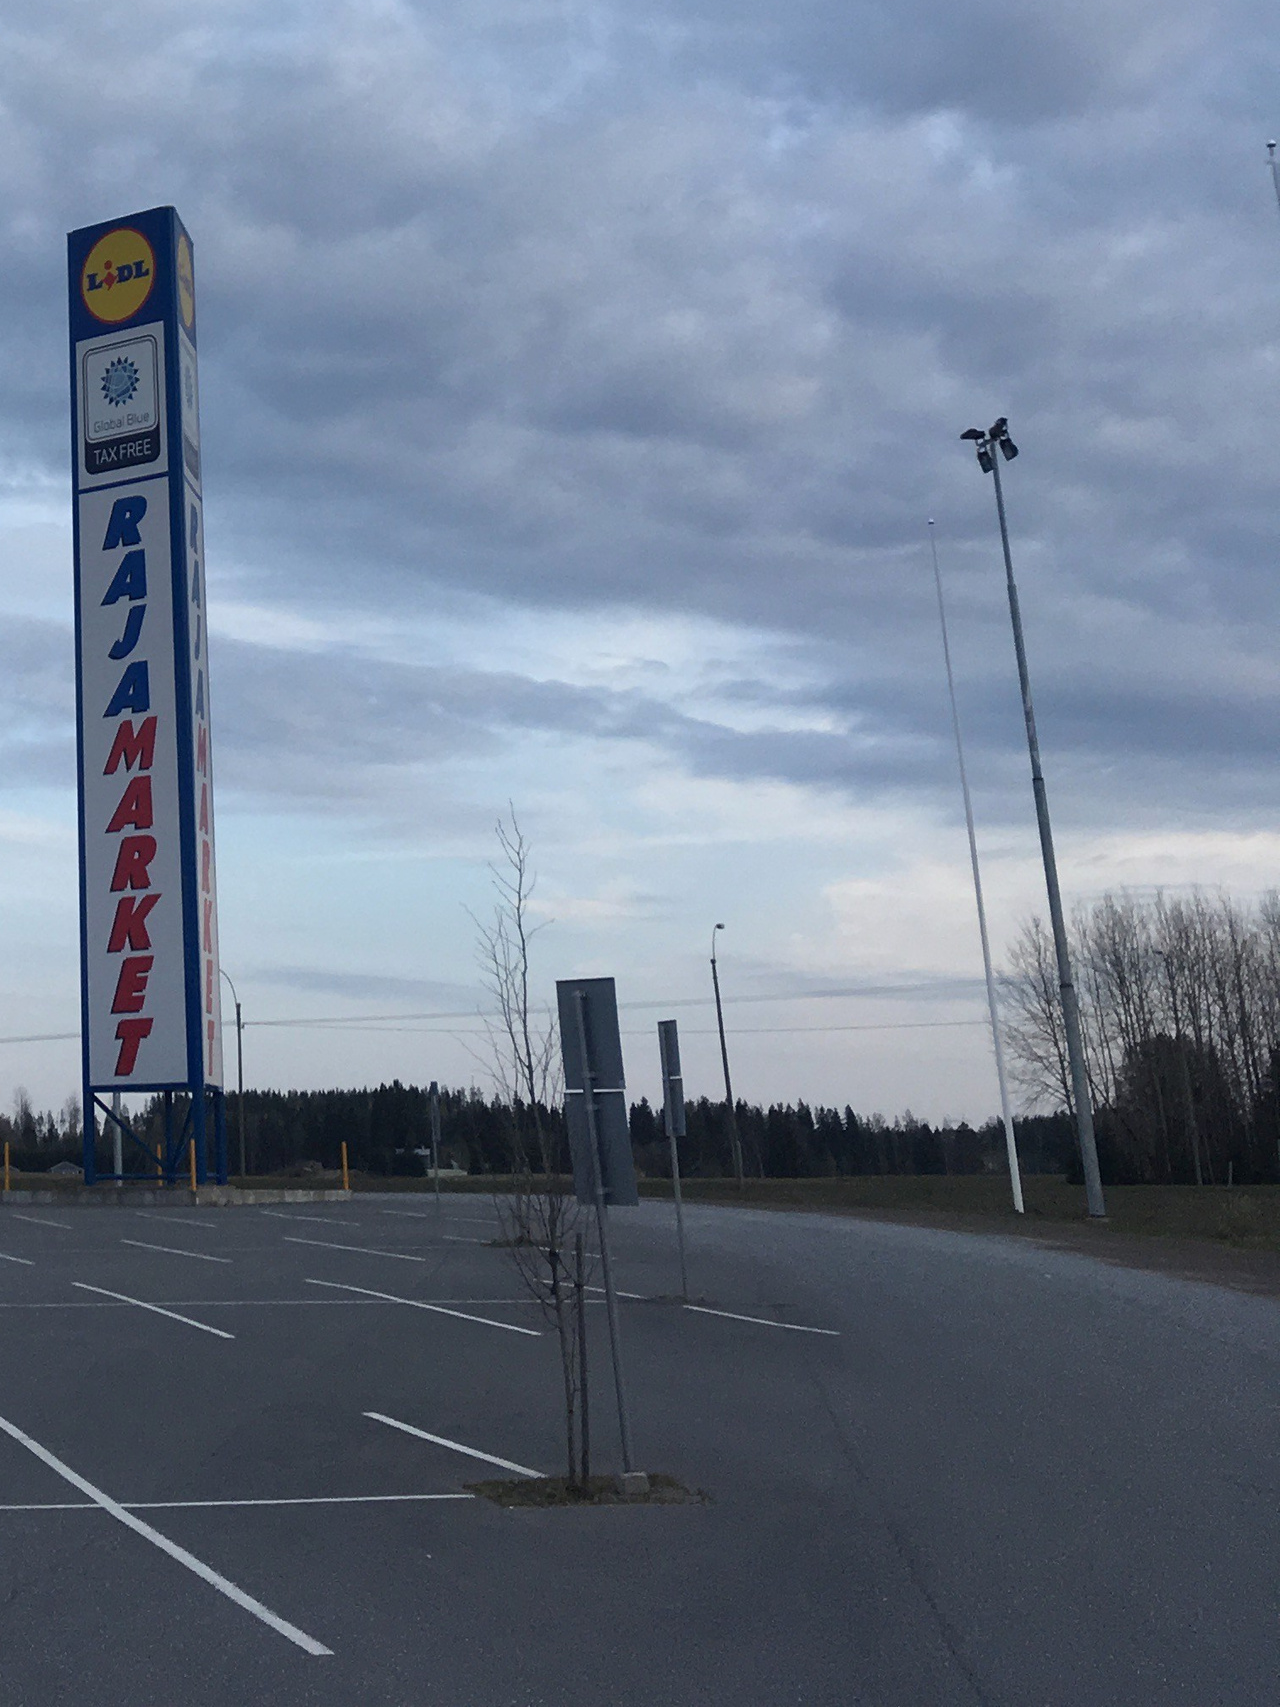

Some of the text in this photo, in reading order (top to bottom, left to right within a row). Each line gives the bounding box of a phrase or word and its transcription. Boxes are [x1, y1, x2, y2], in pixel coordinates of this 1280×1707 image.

[94, 412, 149, 433] Global Blue
[94, 438, 151, 465] TAX FREE
